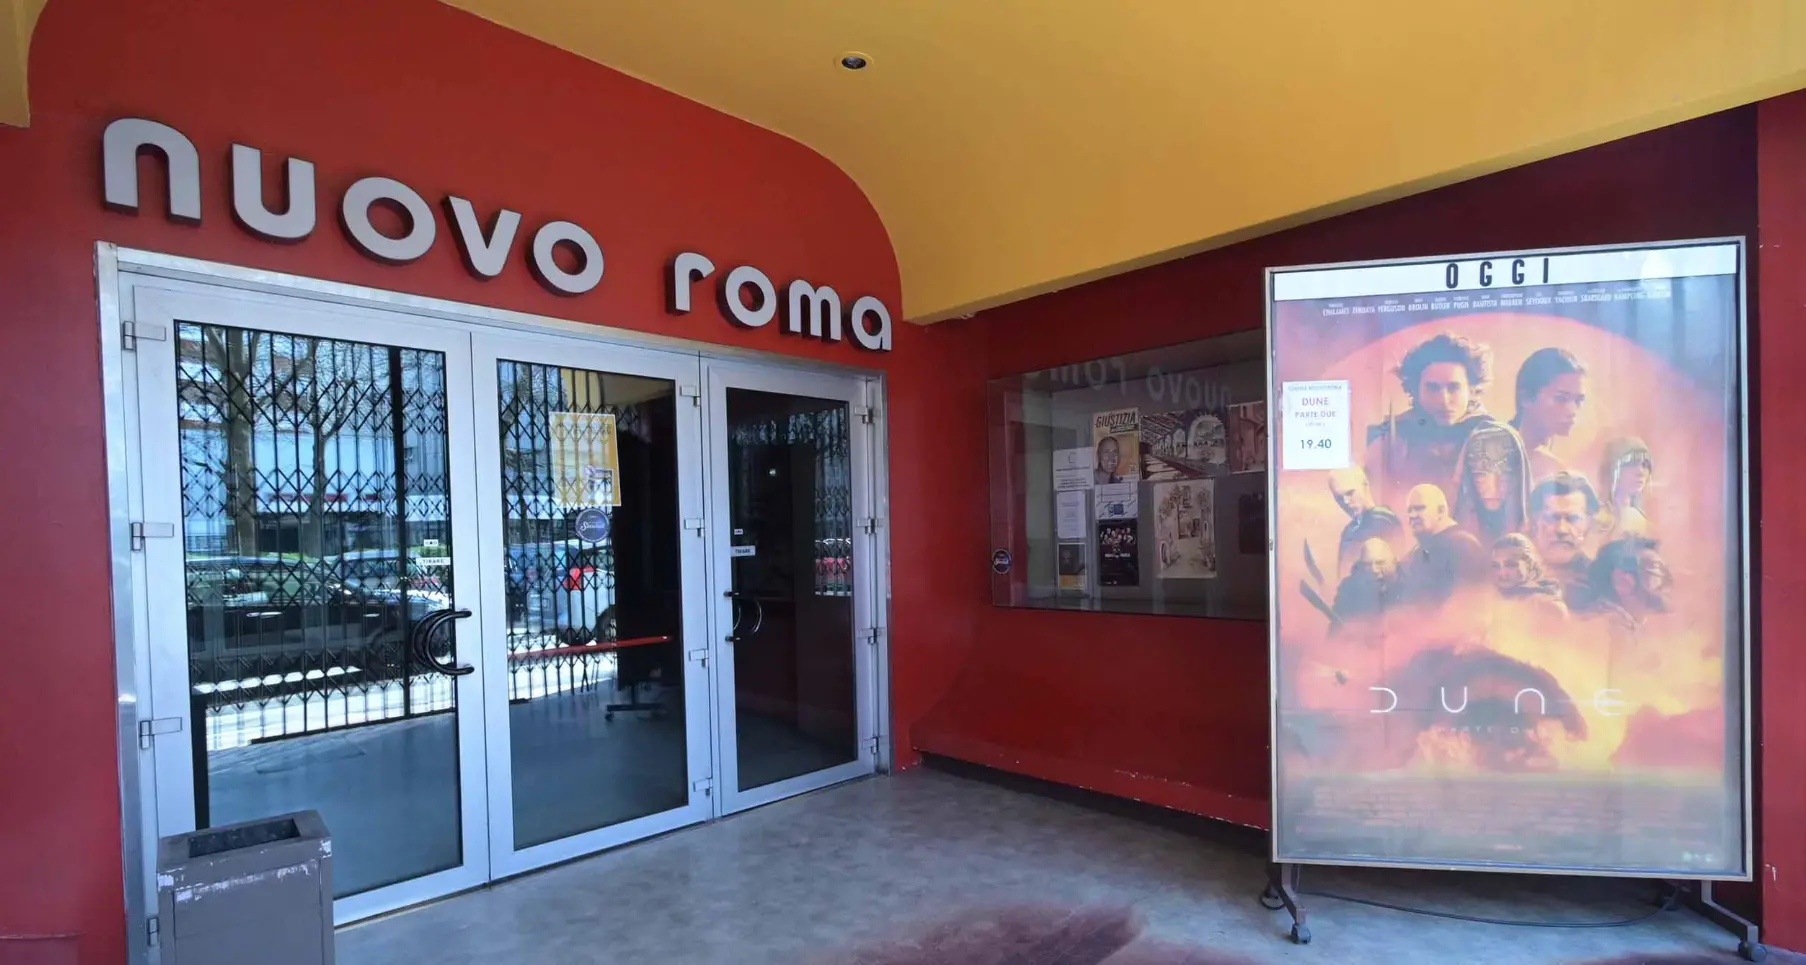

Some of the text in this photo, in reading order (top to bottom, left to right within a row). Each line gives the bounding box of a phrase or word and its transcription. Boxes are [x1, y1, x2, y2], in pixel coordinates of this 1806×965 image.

[102, 117, 893, 352] nuovo roma
[1446, 257, 1549, 289] OGGI
[1302, 397, 1329, 406] DUNE
[1095, 411, 1136, 428] GIUSTIZIA
[1320, 410, 1337, 418] DUE
[1301, 438, 1332, 449] 19.40
[1369, 685, 1623, 716] DUNE
